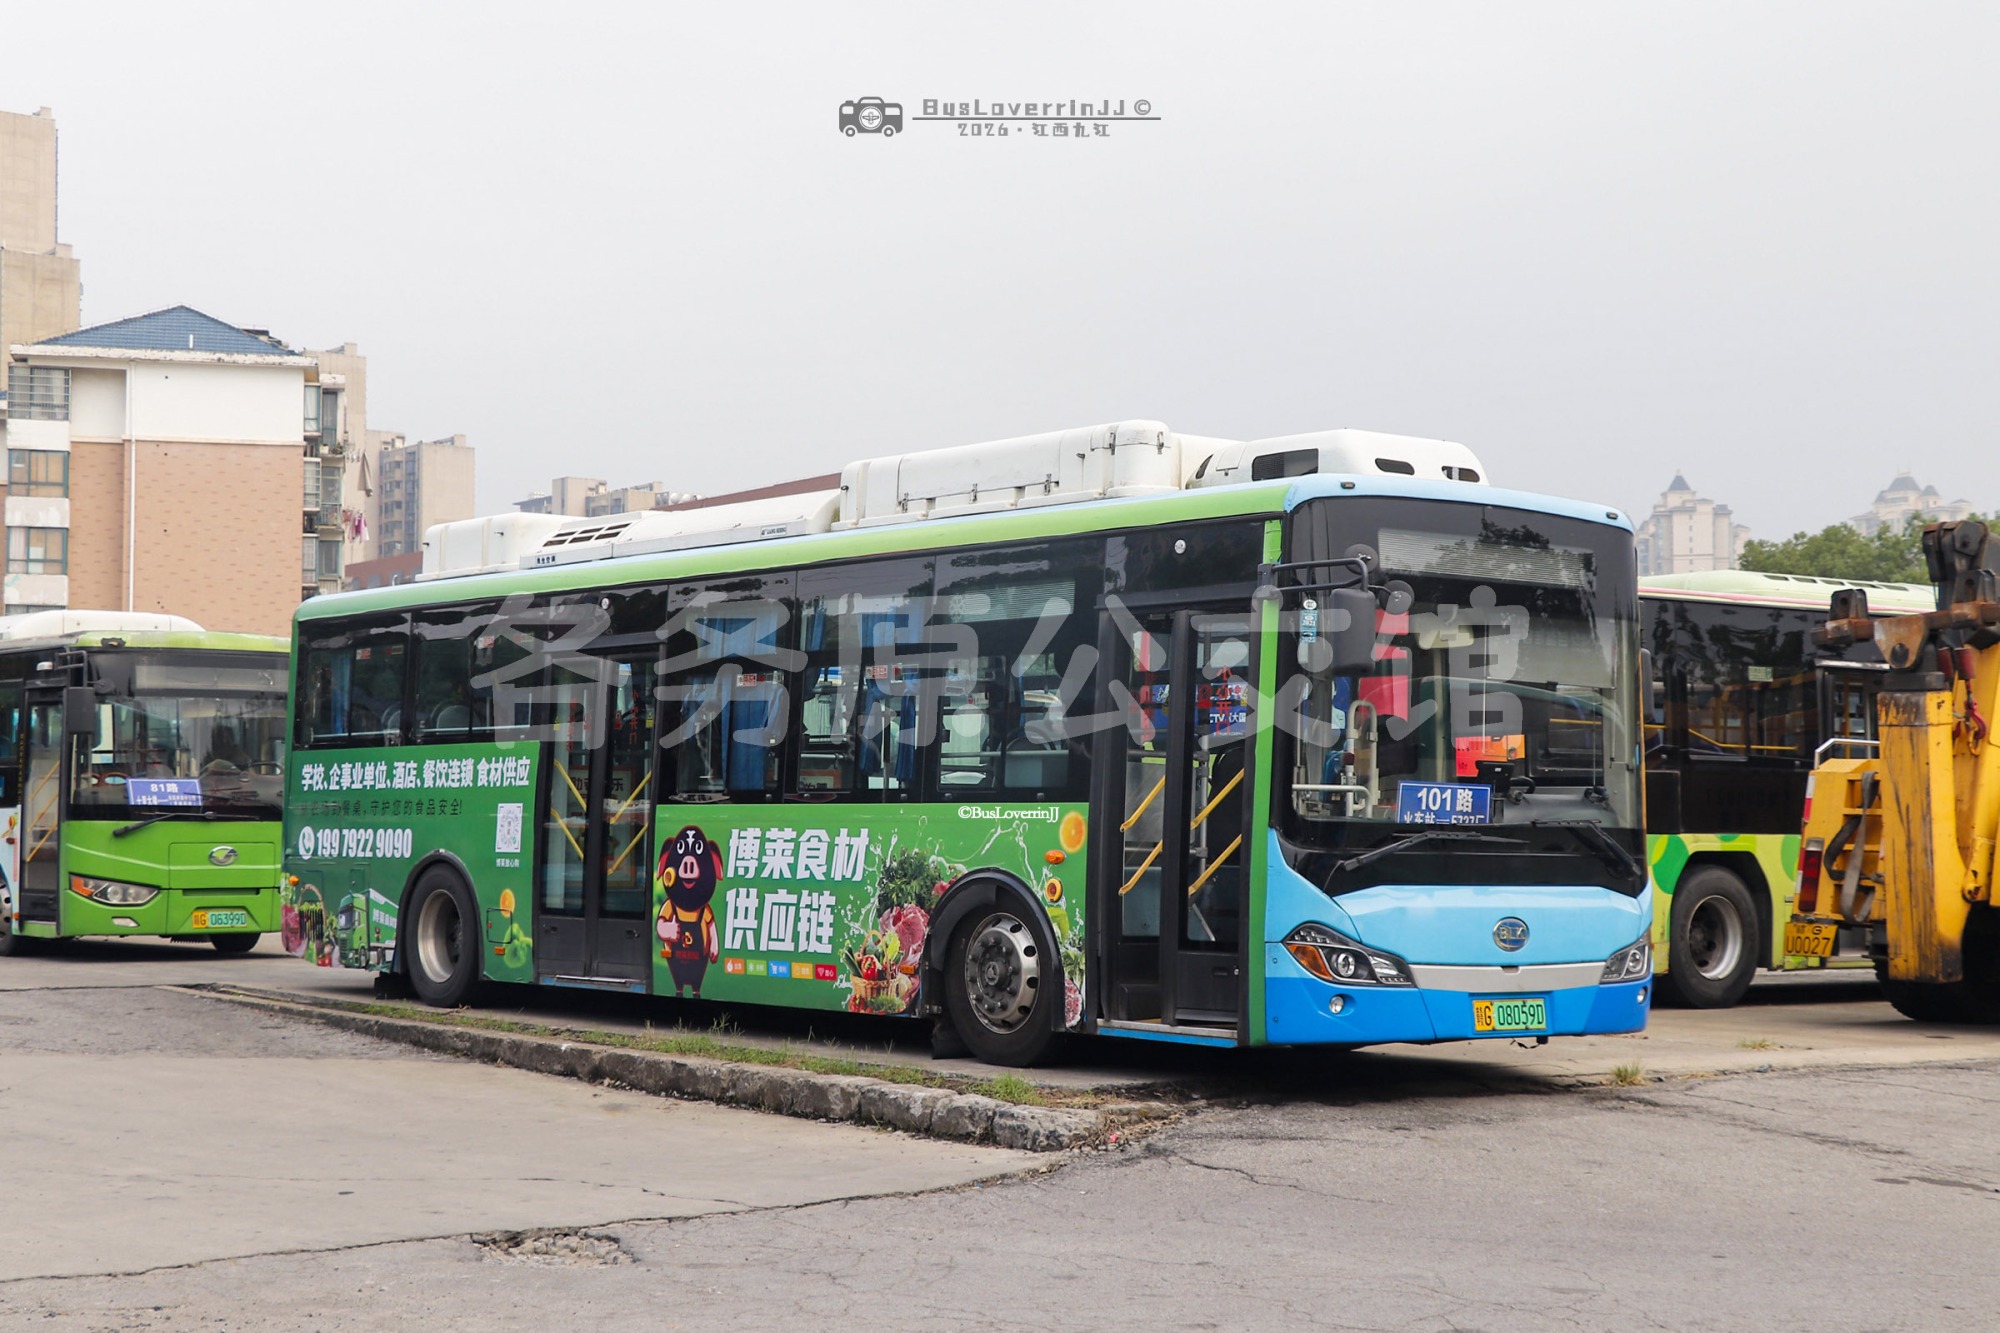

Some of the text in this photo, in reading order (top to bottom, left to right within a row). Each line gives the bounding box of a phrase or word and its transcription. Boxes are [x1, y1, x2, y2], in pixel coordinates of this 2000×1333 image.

[477, 756, 530, 786] 食材供应
[1417, 787, 1473, 813] 101路
[316, 828, 413, 859] 199 7922 9090
[727, 827, 870, 882] 博莱食材
[724, 887, 836, 954] 供应链
